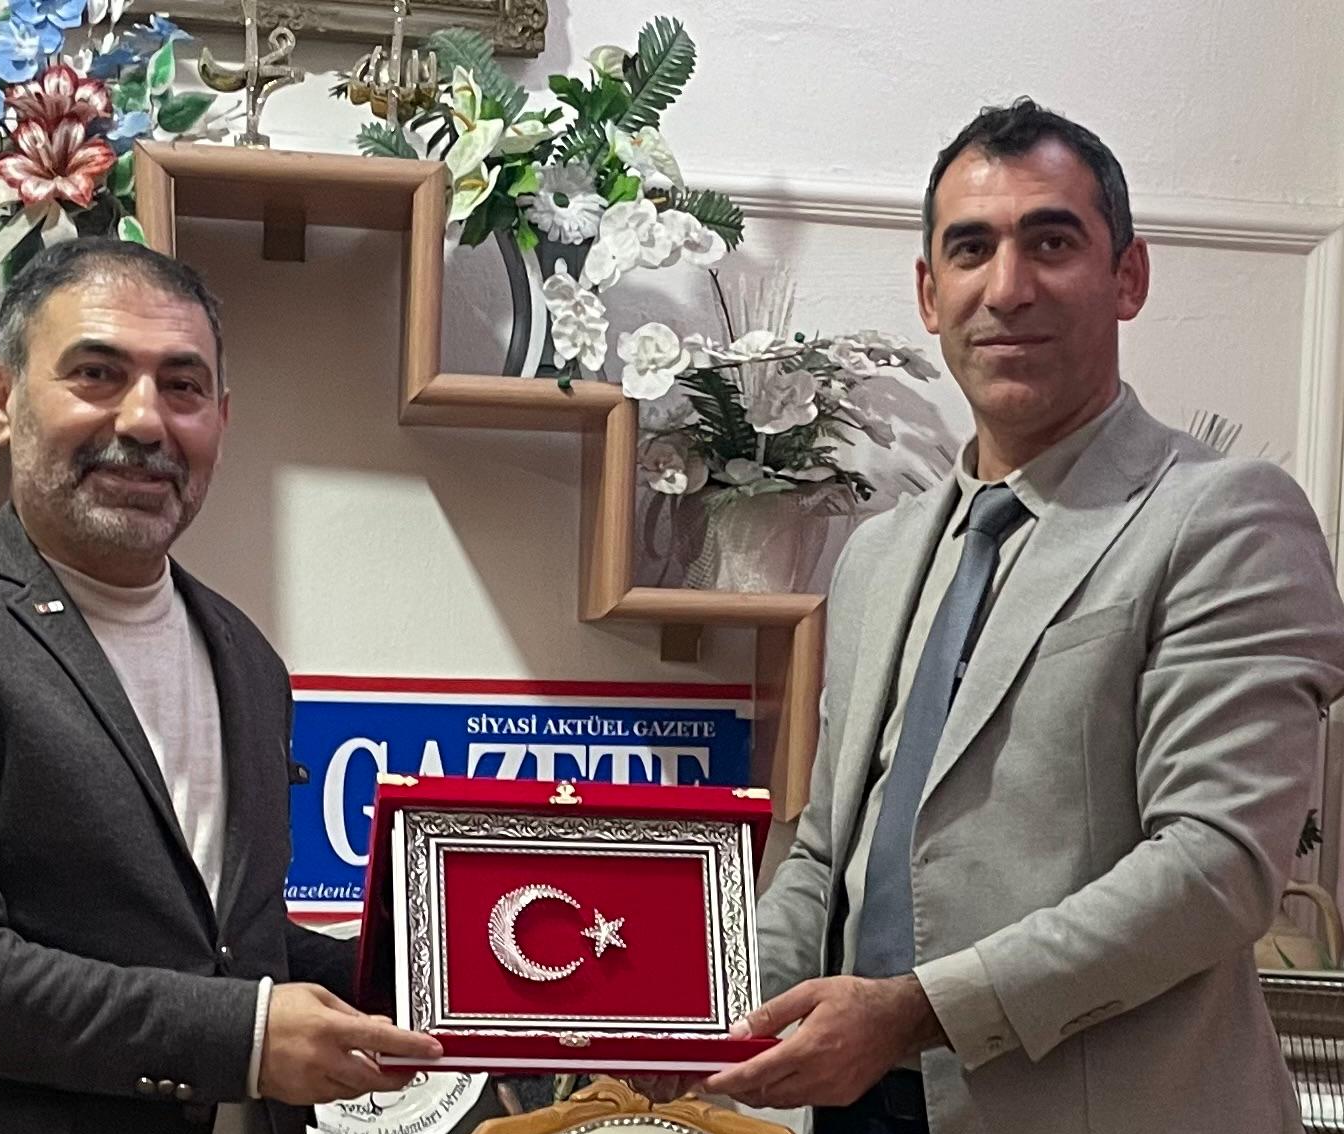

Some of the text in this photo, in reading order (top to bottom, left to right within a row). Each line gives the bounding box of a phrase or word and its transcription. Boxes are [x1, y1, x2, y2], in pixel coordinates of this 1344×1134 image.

[466, 713, 716, 739] SİYASİ AKTÜEL GAZETE
